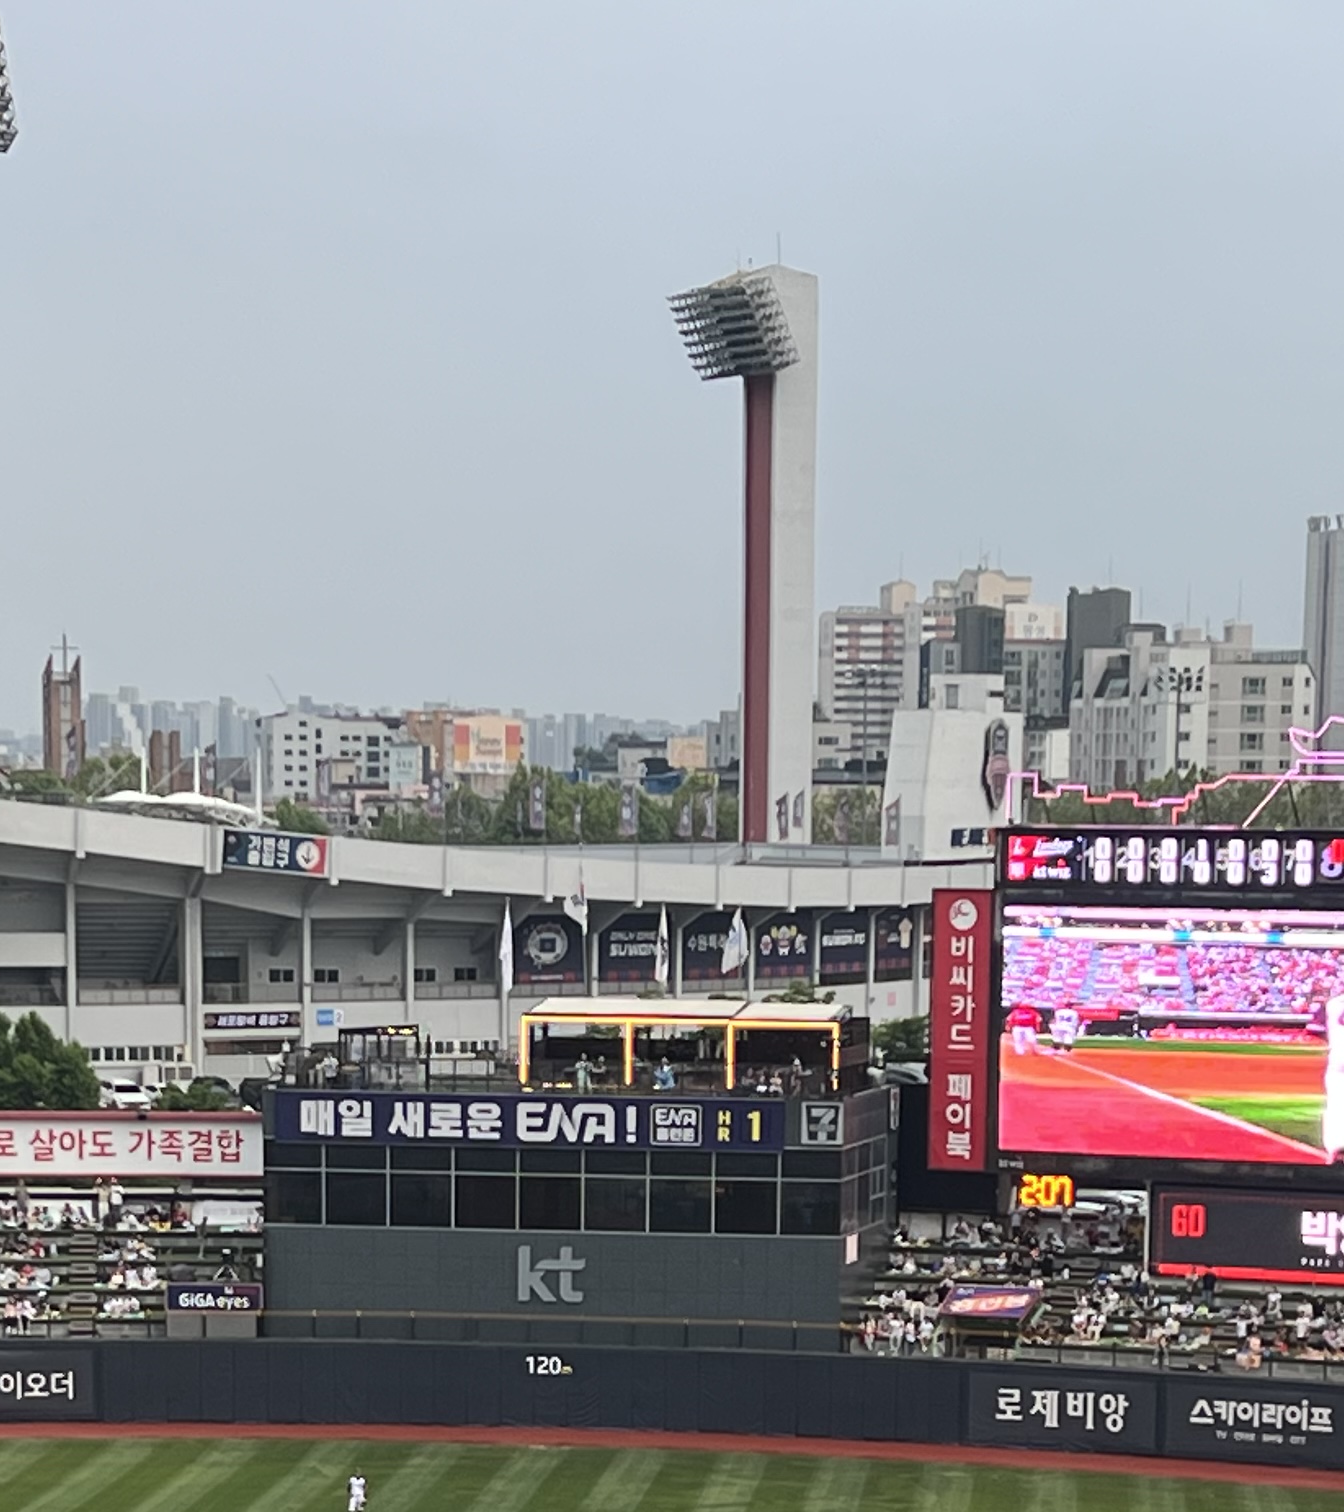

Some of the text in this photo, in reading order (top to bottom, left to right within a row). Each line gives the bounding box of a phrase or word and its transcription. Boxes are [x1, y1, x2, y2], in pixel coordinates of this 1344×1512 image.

[946, 934, 977, 1051] 비씨카드
[298, 1099, 638, 1144] 매일 새로운 ENA!
[654, 1107, 698, 1128] ENA
[746, 1110, 761, 1142] 1
[945, 1073, 973, 1161] 페이북
[29, 1128, 118, 1162] 살아도
[127, 1129, 244, 1164] 가족결합
[1018, 1173, 1075, 1208] 2:07
[1171, 1203, 1206, 1238] 60
[516, 1245, 587, 1304] kt
[994, 1387, 1130, 1434] 로제비앙
[1188, 1398, 1335, 1434] 스카이라이프
